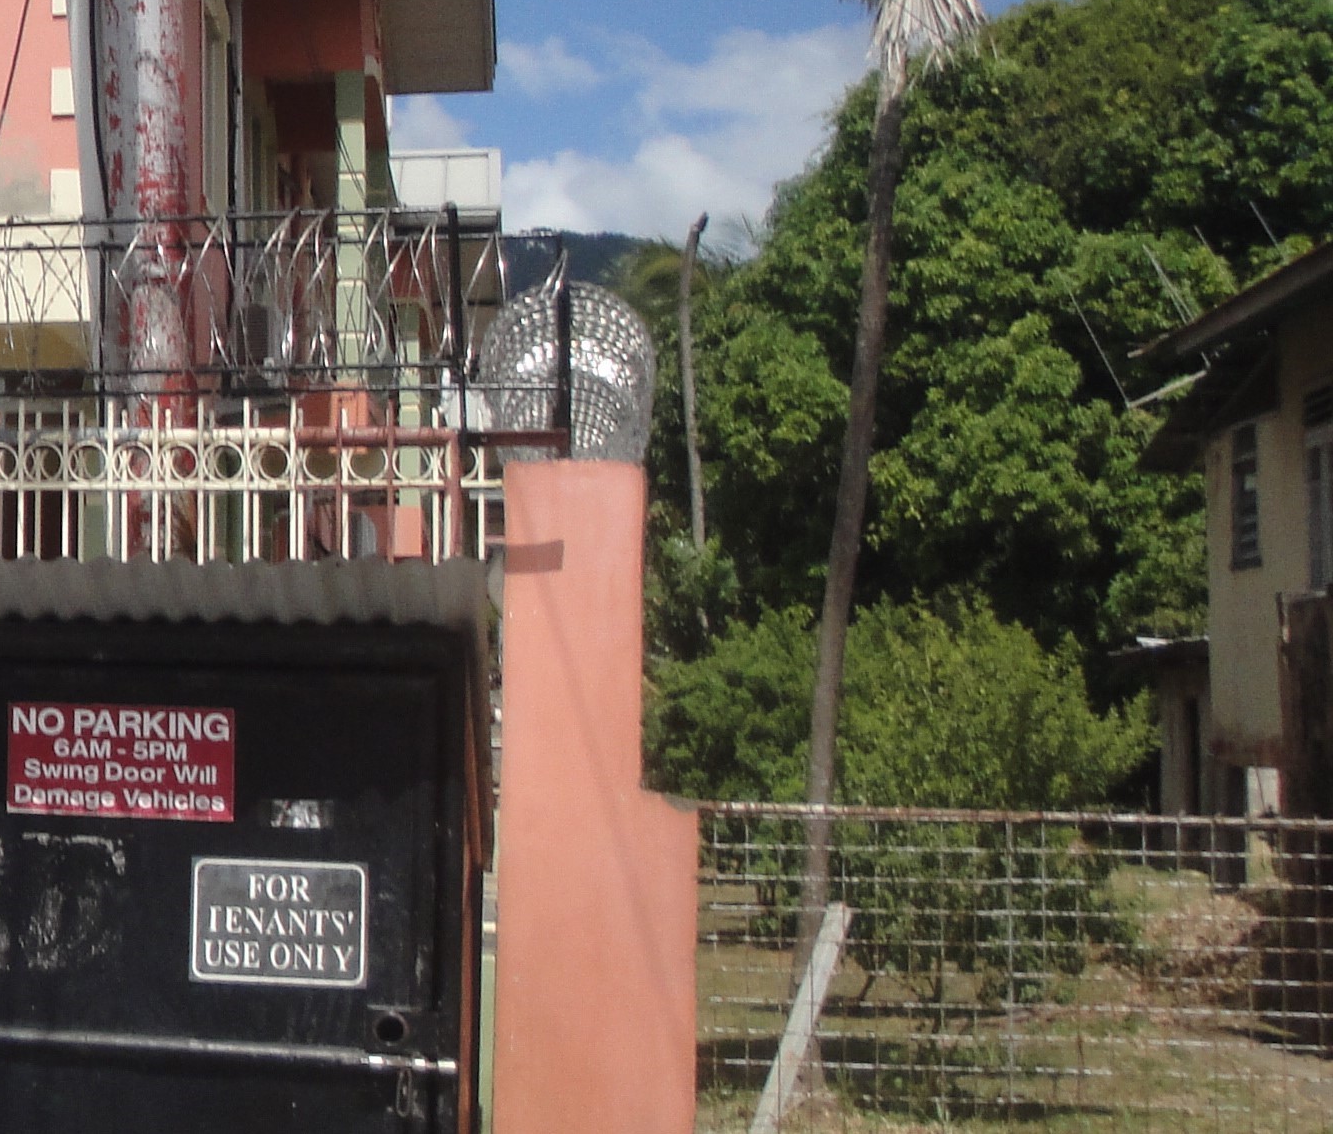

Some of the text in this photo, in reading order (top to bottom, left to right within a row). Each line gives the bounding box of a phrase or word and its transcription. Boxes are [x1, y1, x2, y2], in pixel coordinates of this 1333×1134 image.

[13, 707, 230, 742] NO PARKING
[53, 738, 111, 759] 6AM
[133, 740, 187, 761] 5PM
[24, 758, 217, 785] Swing Door Will
[14, 784, 225, 812] Damage Vehicles
[248, 873, 310, 903] FOR
[204, 939, 354, 972] USE ONLY
